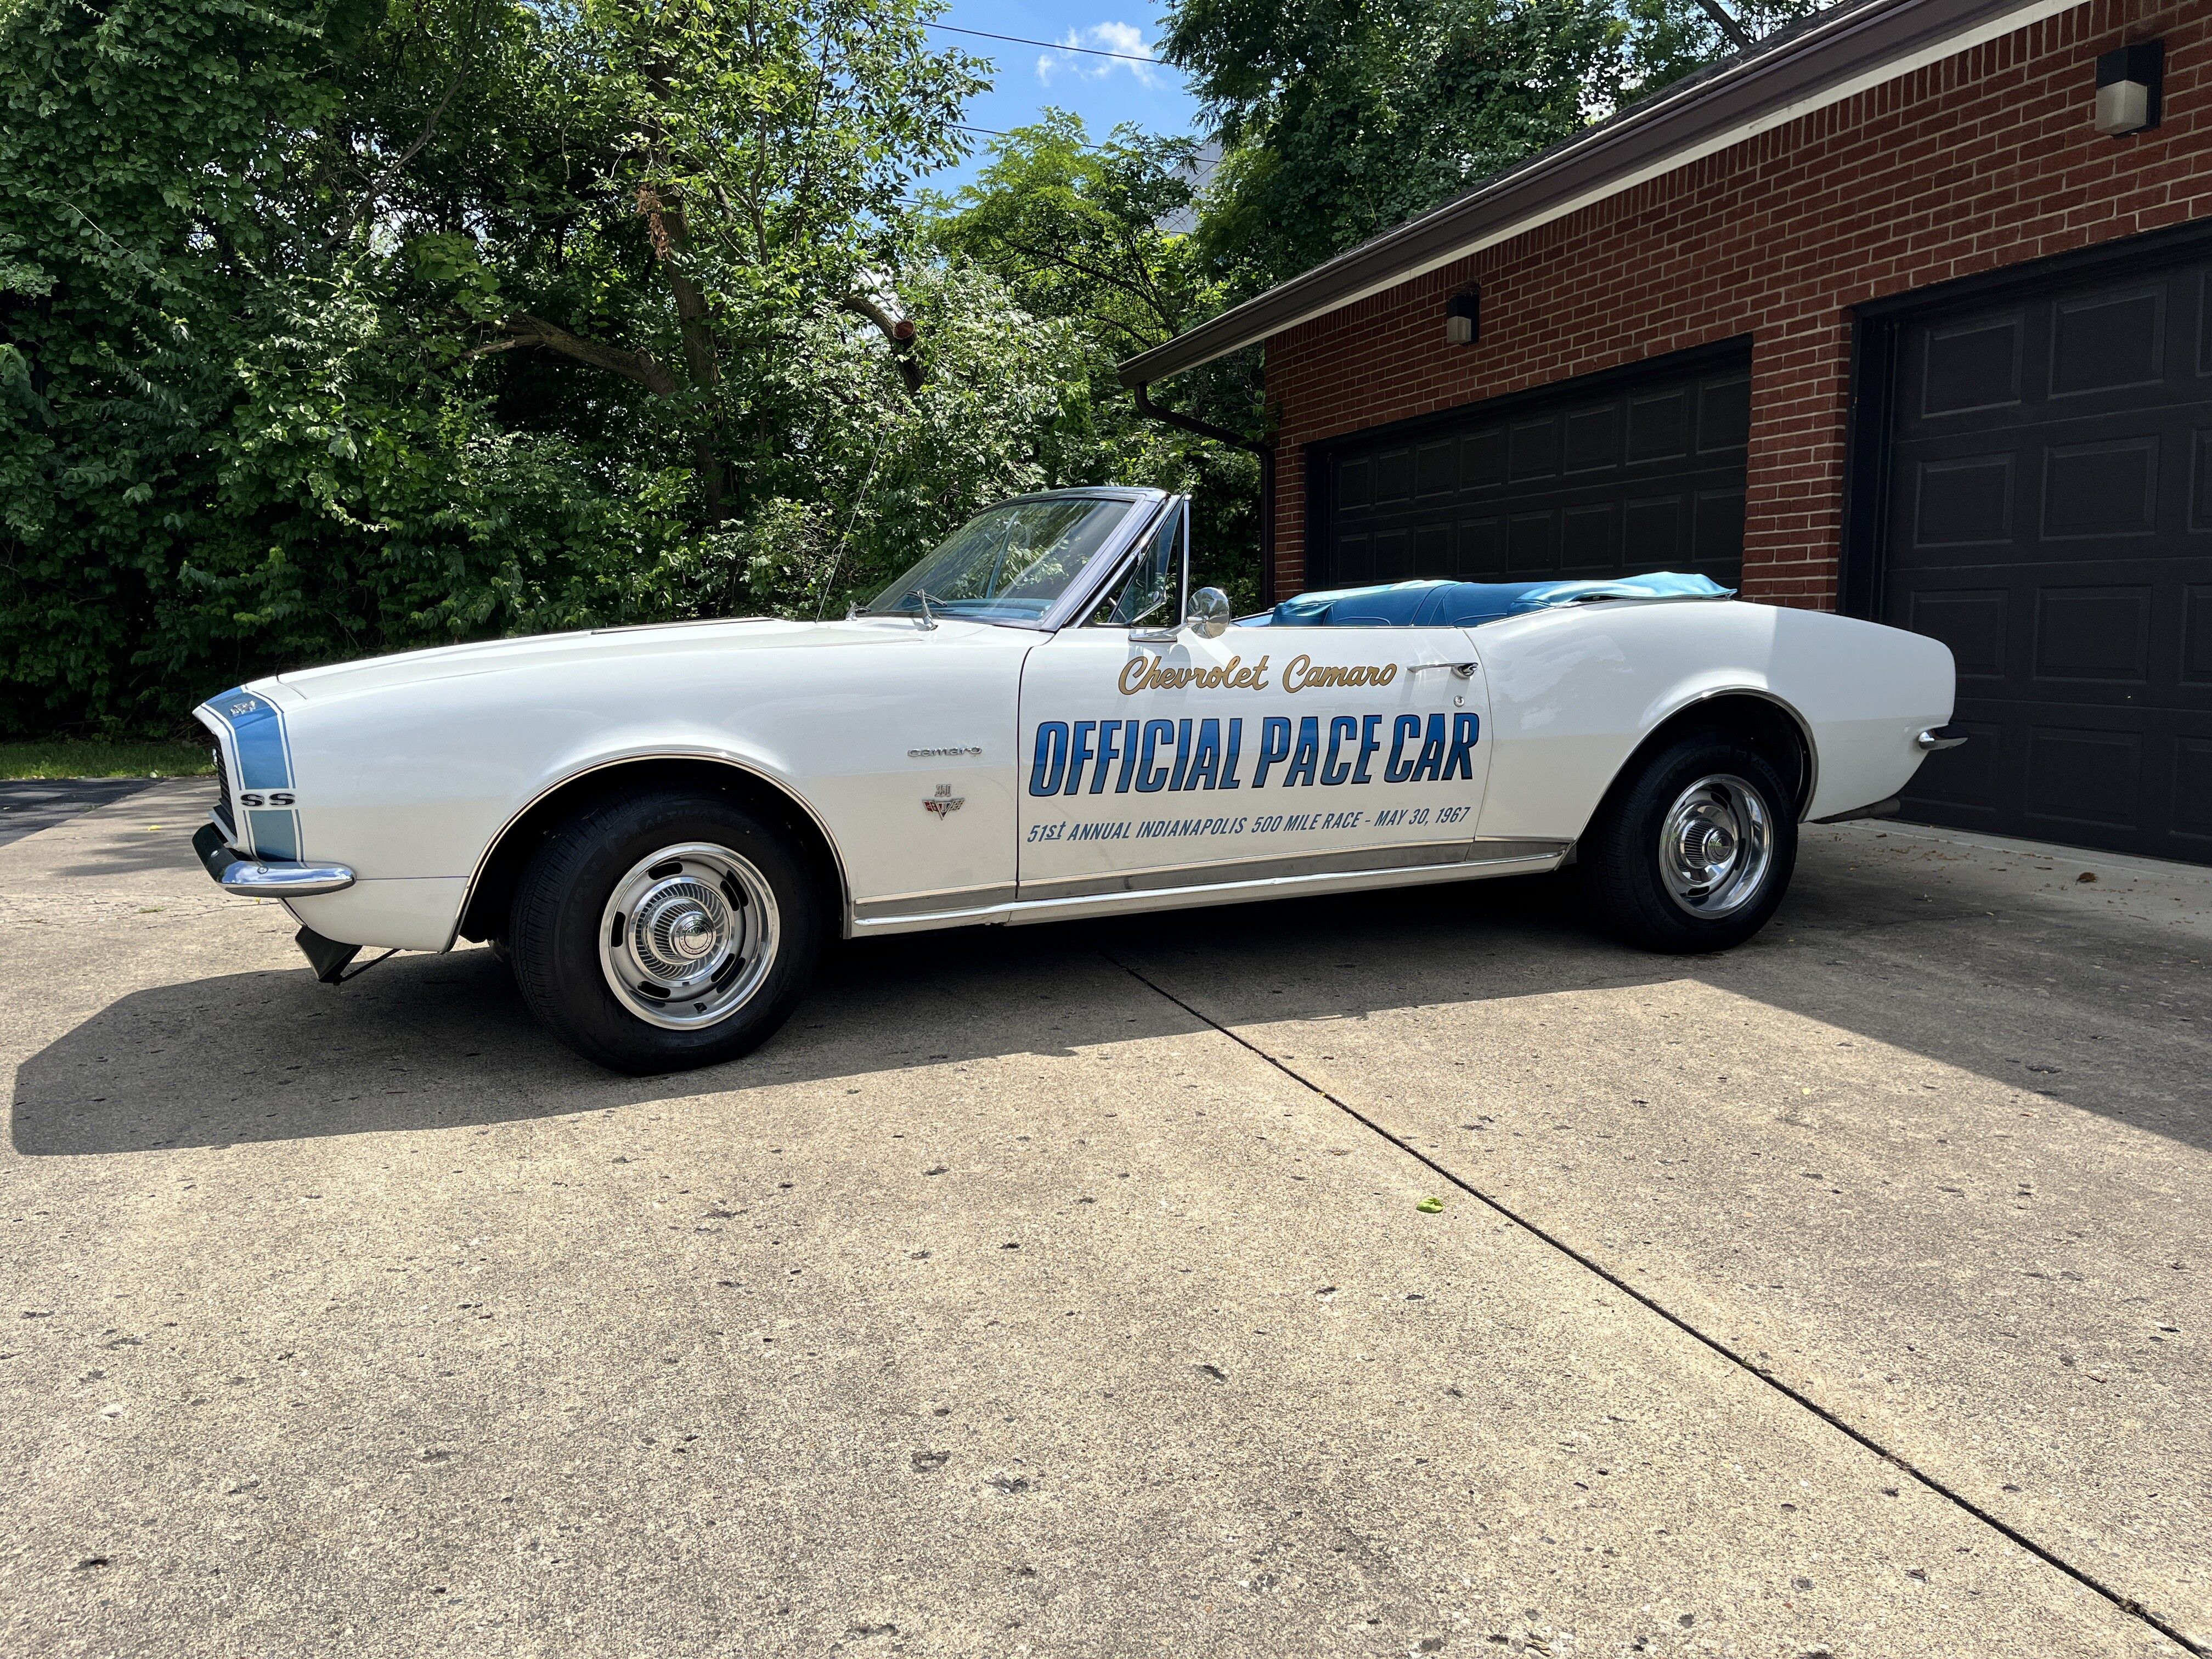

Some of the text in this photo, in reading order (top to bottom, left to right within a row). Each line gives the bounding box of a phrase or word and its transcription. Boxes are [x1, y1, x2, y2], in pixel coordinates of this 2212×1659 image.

[1118, 654, 1397, 695] Chevrolet Camaro
[1029, 712, 1480, 797] OFFICIAL PACE CAR
[240, 793, 295, 806] SS
[1027, 821, 1066, 843] 51st
[1066, 821, 1132, 841] ANNUAL
[1135, 816, 1248, 839] INDIANAPOLIS
[1251, 815, 1283, 833] 500
[1283, 813, 1322, 832] MILE
[1321, 811, 1364, 830] RACE
[1374, 809, 1409, 827] MAY
[1408, 808, 1430, 827] 30,
[1435, 806, 1471, 823] 1967
